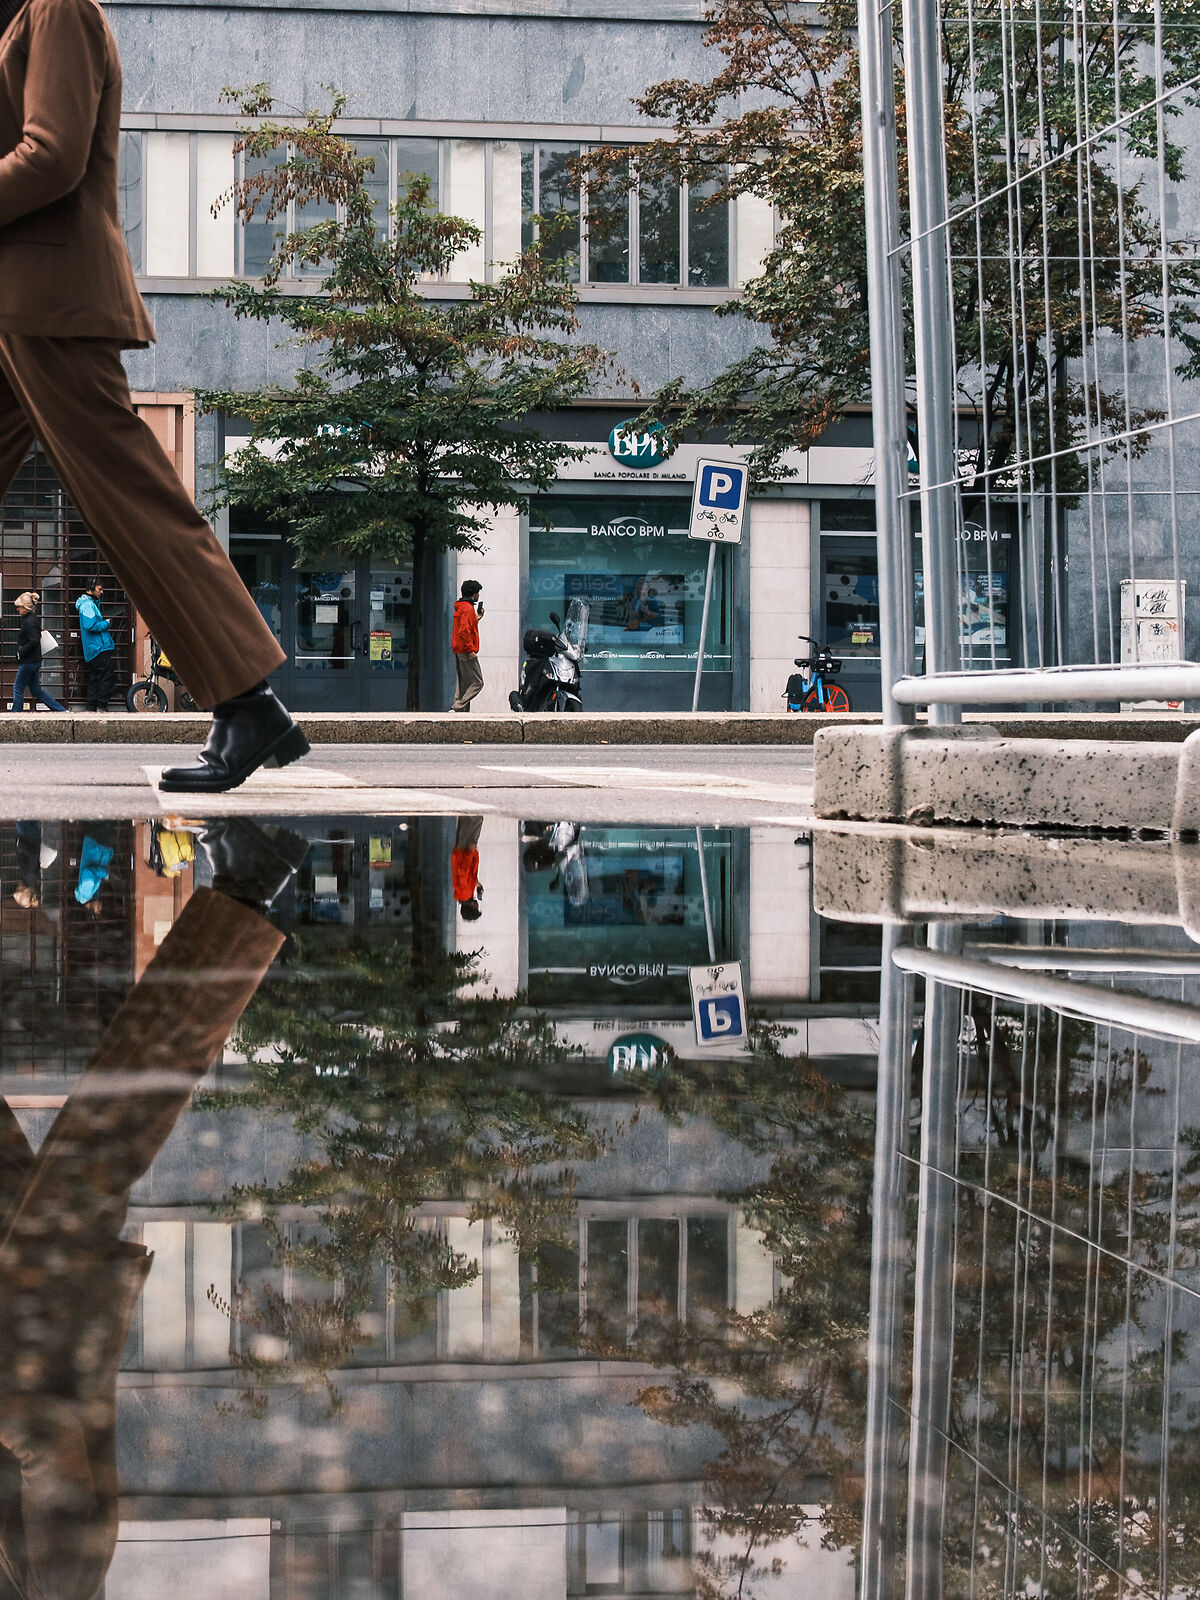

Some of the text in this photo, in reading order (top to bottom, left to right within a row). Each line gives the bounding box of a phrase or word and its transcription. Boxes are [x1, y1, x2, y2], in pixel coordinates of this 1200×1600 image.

[708, 472, 733, 502] P
[591, 525, 665, 537] BANCO BPM
[973, 530, 998, 541] BPM
